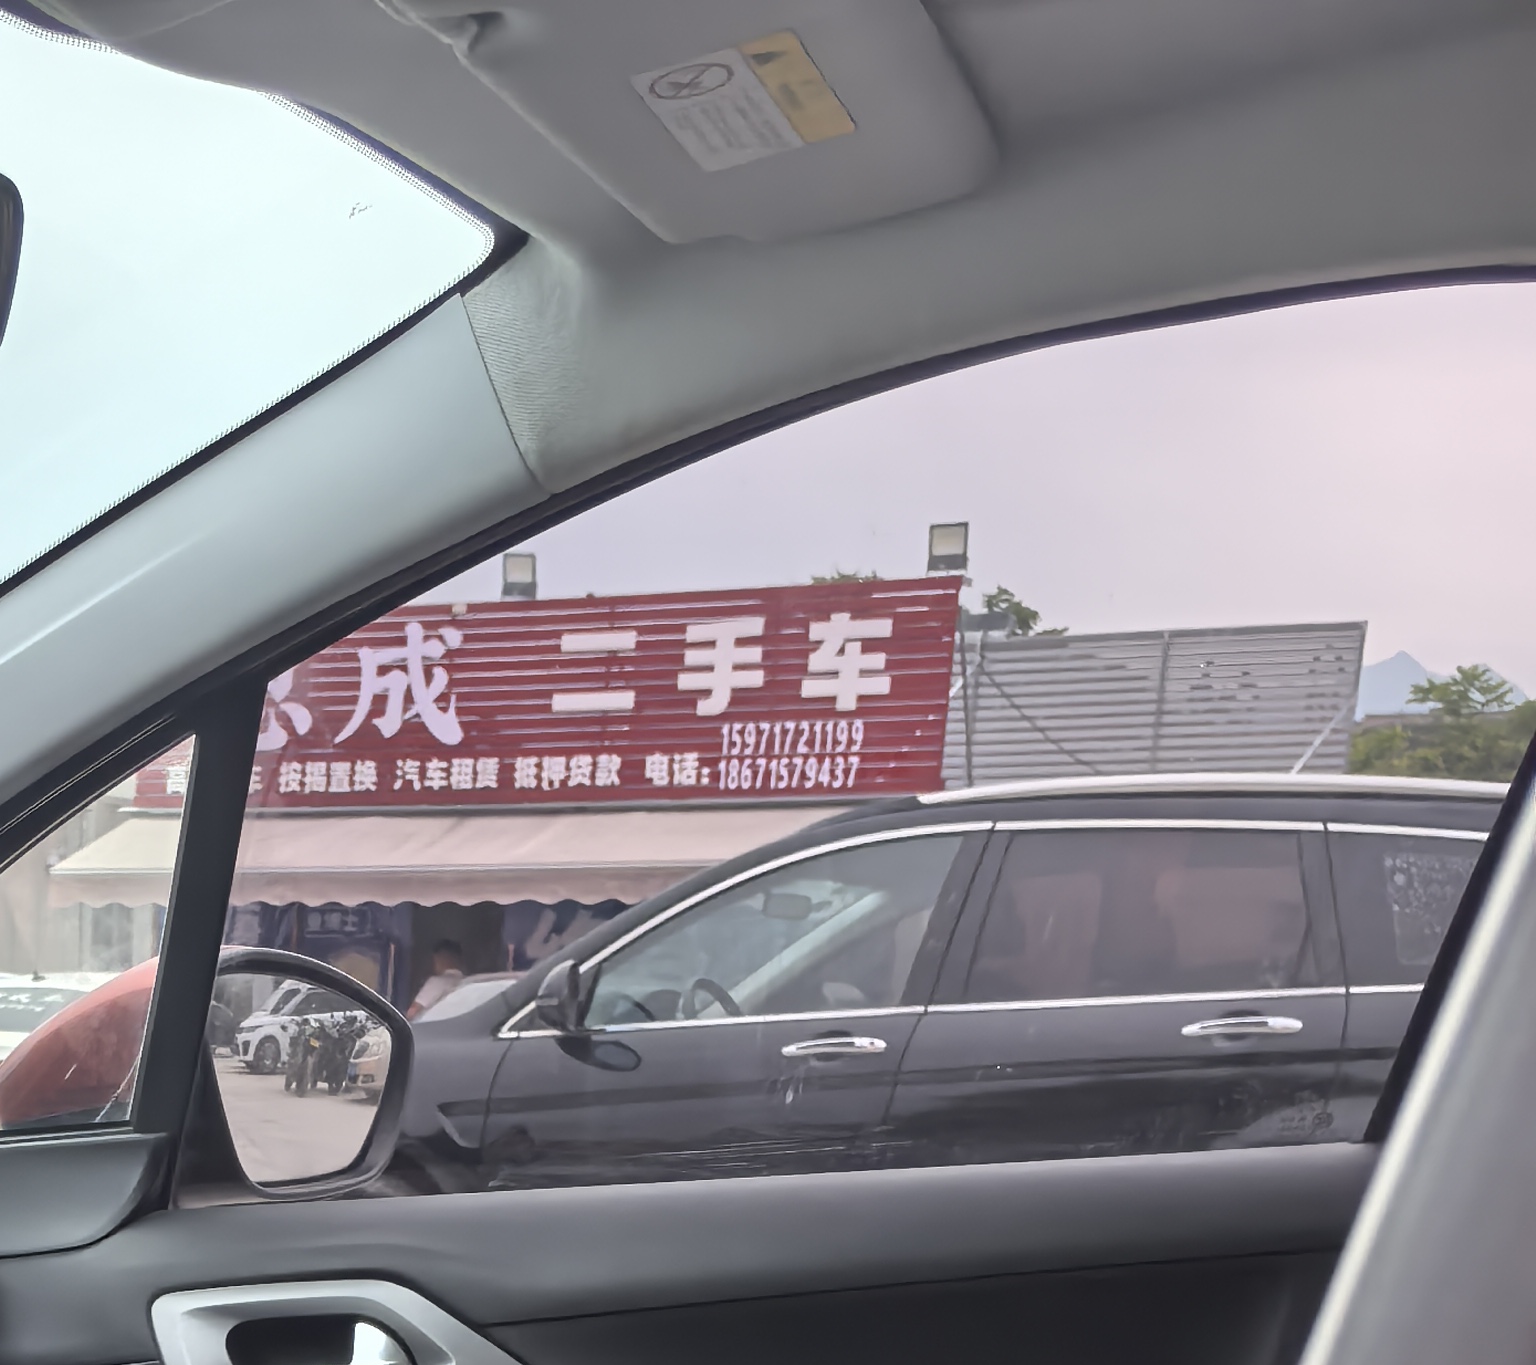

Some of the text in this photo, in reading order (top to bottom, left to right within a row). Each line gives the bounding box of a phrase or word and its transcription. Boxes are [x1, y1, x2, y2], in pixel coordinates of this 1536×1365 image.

[720, 719, 864, 756] 15971721199
[393, 757, 500, 791] 汽车租赁
[718, 755, 860, 790] 18671579437
